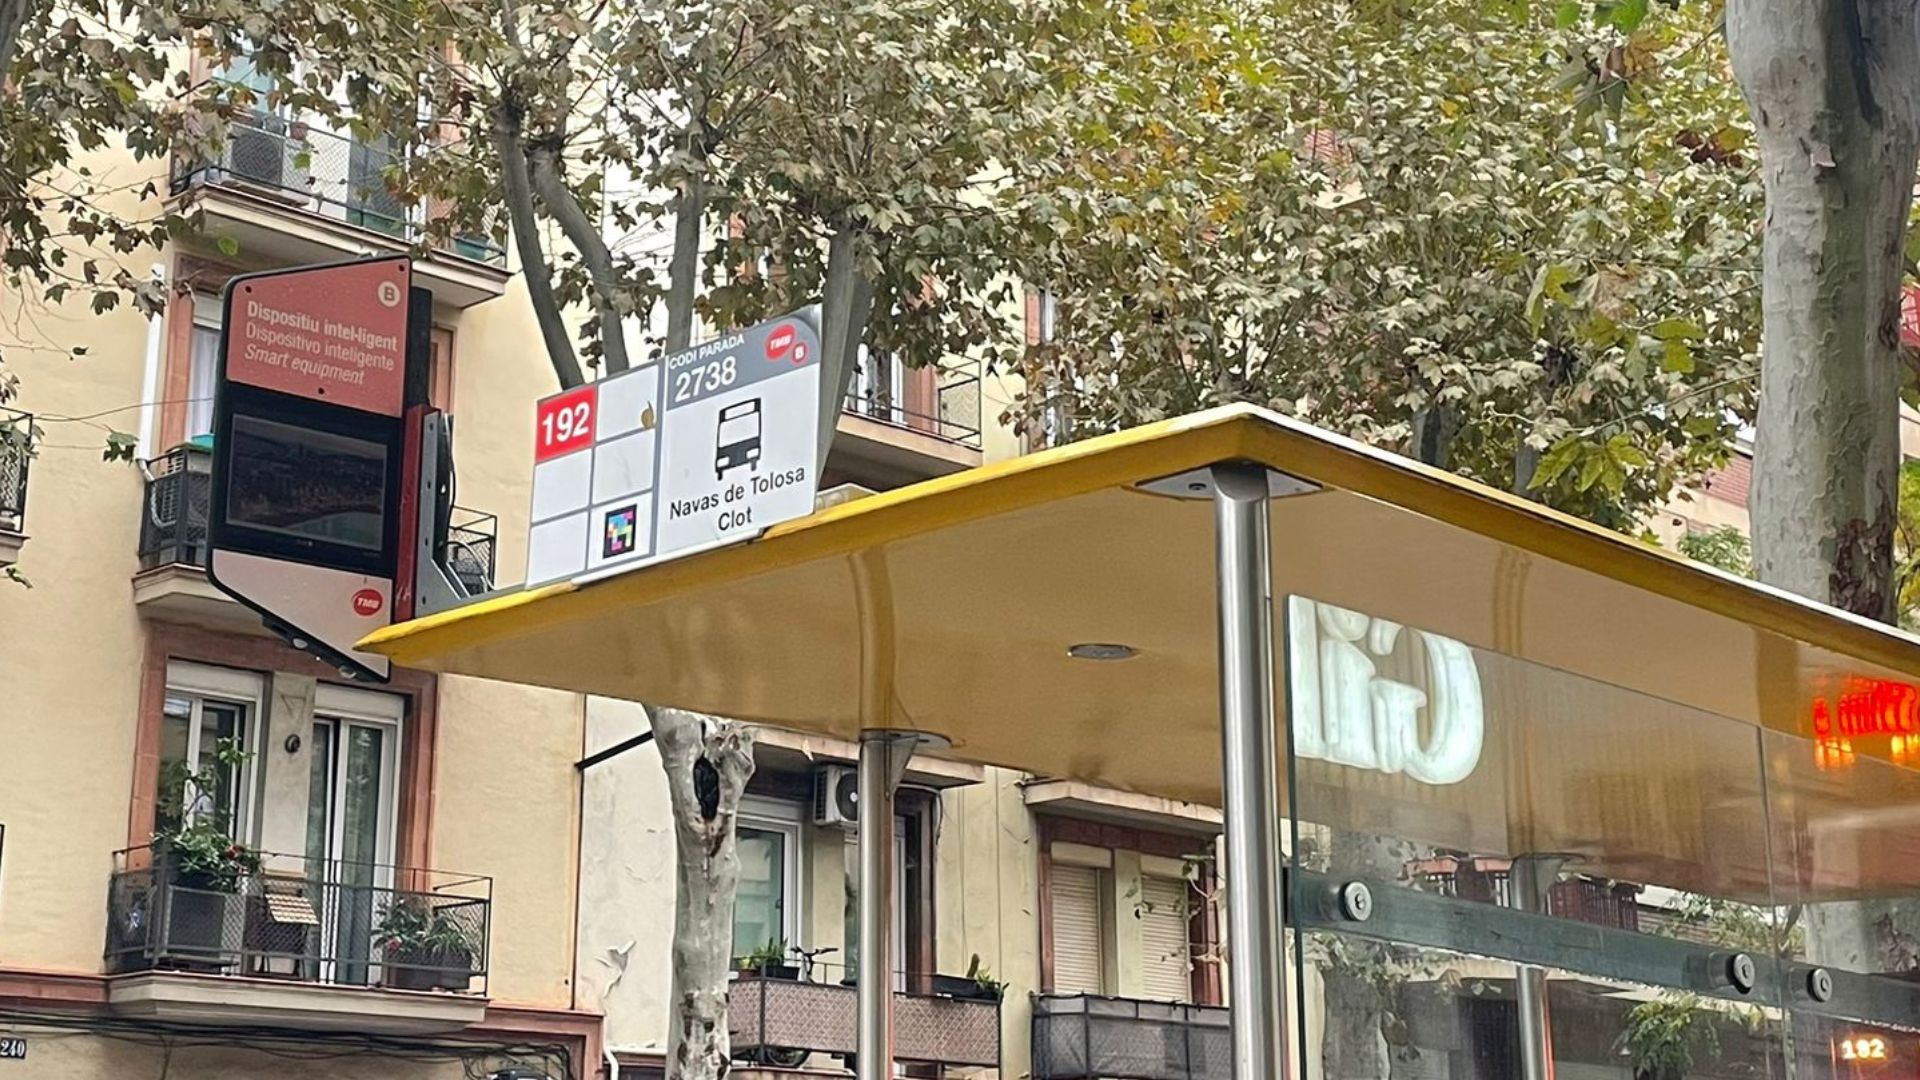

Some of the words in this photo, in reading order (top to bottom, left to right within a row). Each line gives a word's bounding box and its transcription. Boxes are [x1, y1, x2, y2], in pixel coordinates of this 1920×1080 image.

[247, 300, 319, 333] Dispositiu
[244, 343, 289, 368] Smart
[290, 356, 365, 386] equipment
[245, 321, 321, 355] Dispositivo
[324, 342, 394, 371] inteligente
[669, 351, 697, 370] CODI
[699, 333, 745, 359] PARADA
[674, 356, 737, 403] 2738
[541, 401, 591, 446] 192
[669, 489, 719, 520] Navas
[724, 484, 744, 503] de
[749, 467, 805, 496] Tolosa
[717, 507, 752, 532] Clot
[0, 1039, 25, 1057] 240
